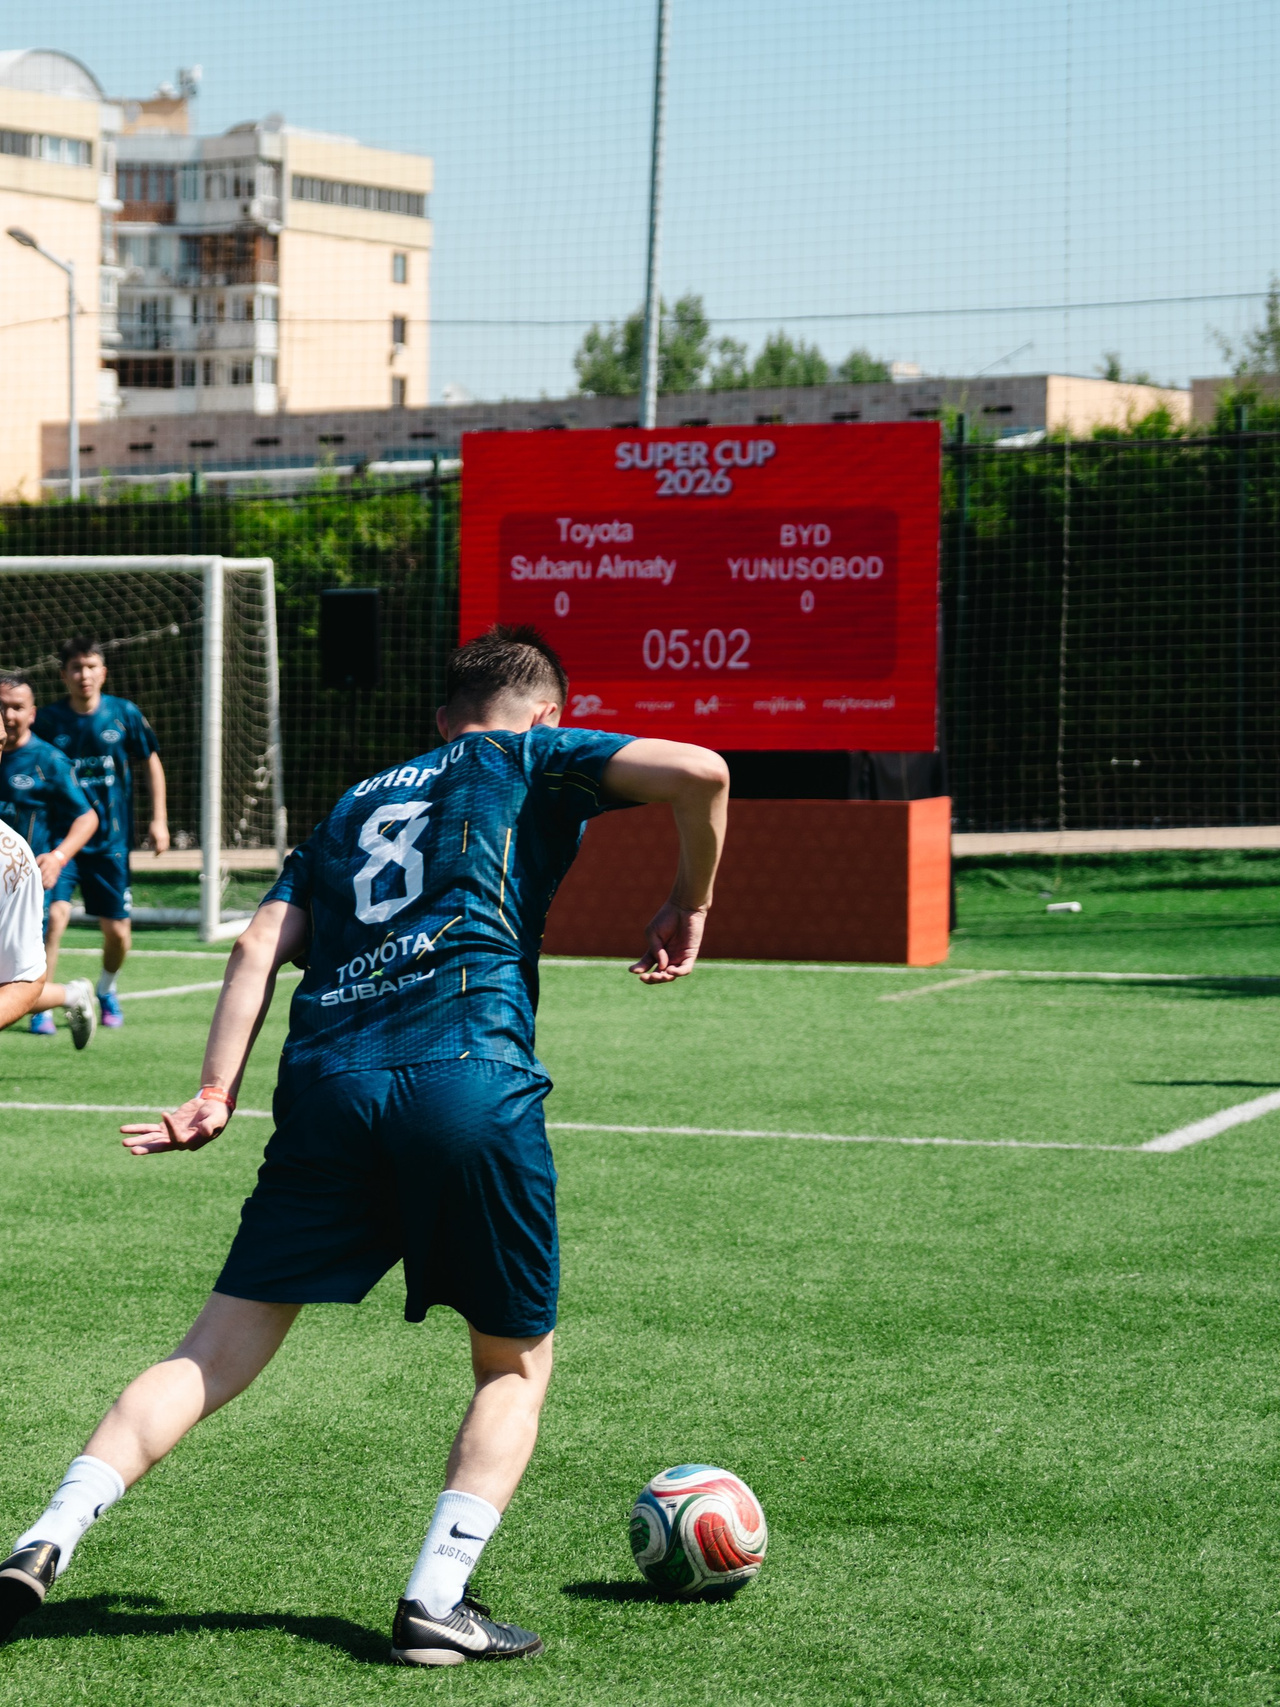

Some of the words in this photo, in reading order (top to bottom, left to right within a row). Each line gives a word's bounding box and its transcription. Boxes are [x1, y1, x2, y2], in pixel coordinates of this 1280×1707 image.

[615, 441, 710, 470] SUPER
[713, 439, 776, 467] CUP
[655, 467, 733, 496] 2026
[556, 517, 634, 549] Toyota
[780, 523, 831, 547] BYD
[511, 555, 592, 580] Subaru
[596, 553, 676, 586] Almaty
[727, 556, 884, 581] YUNUSOBOD
[554, 590, 570, 617] 0
[800, 589, 815, 614] 0
[642, 627, 751, 671] 05:02
[353, 801, 433, 925] 8
[336, 932, 436, 984] TOYOTA
[432, 1543, 461, 1560] JUST
